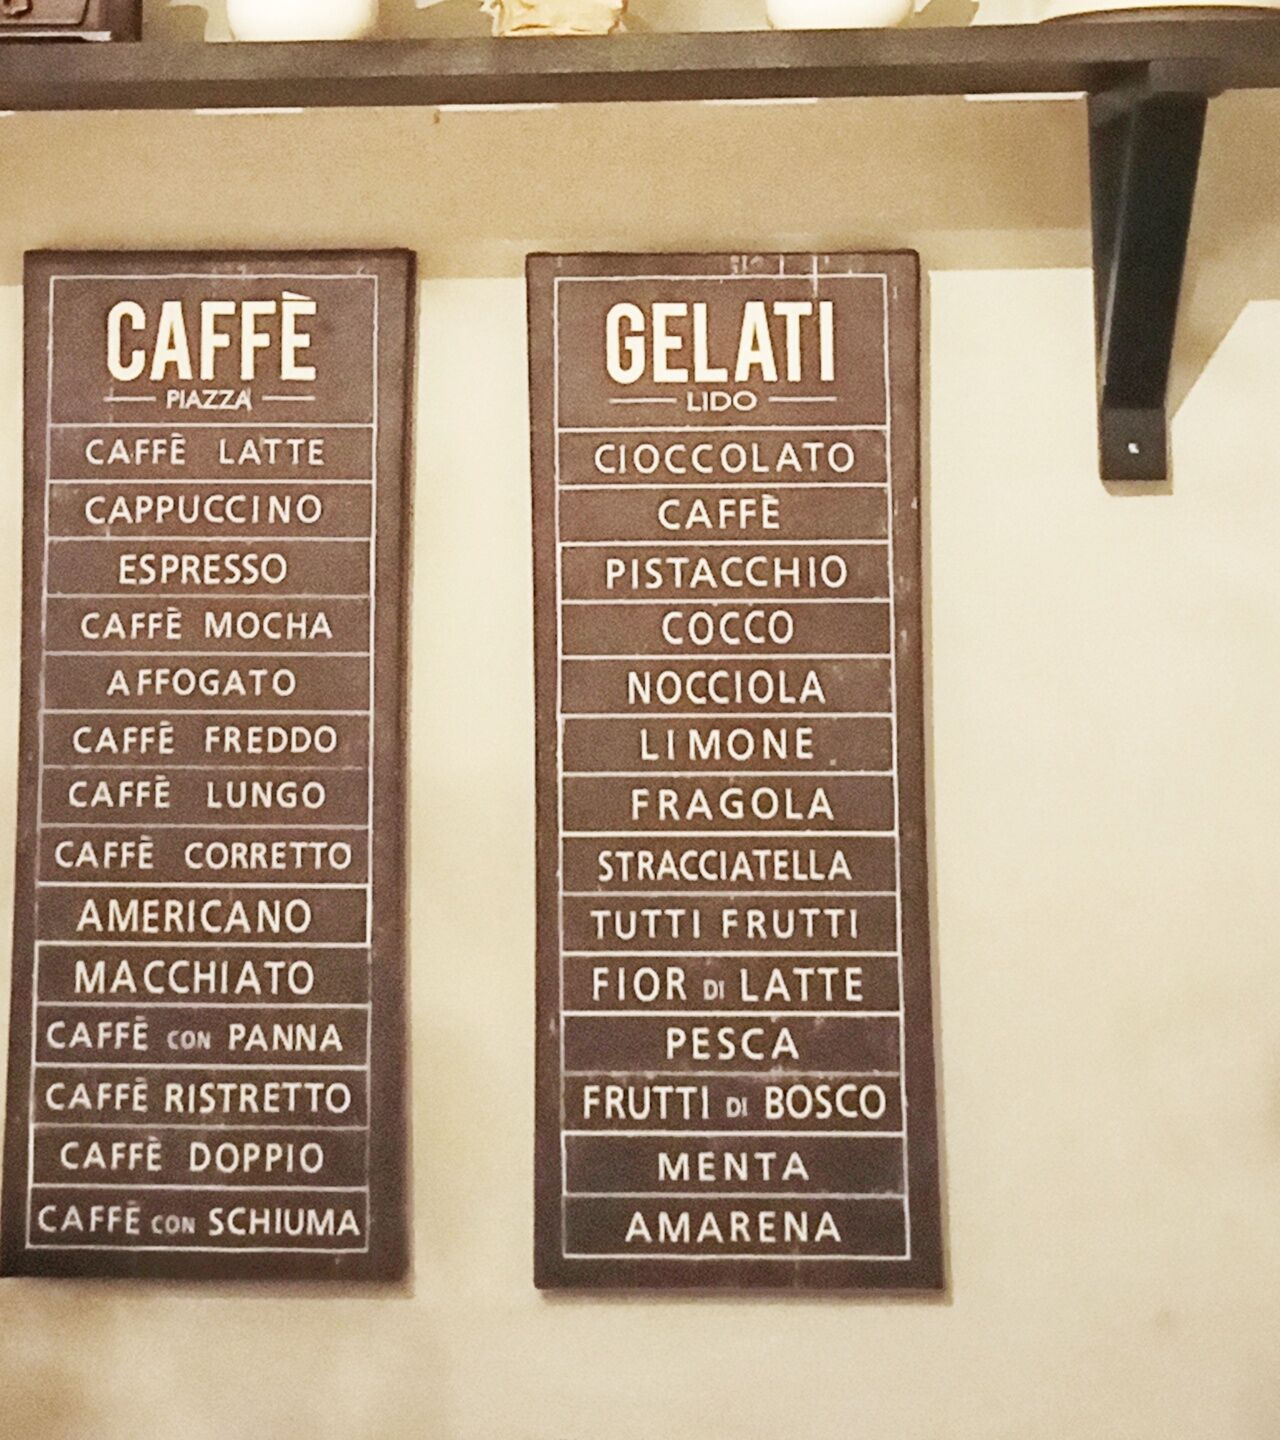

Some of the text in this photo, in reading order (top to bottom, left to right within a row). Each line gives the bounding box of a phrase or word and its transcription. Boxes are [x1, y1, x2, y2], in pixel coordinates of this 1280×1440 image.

[106, 290, 317, 382] CAFFÈ
[605, 300, 835, 385] GELATI
[166, 389, 253, 411] PIAZZA
[686, 390, 758, 413] LIDO
[84, 433, 325, 467] CAFFÈ LATTE
[594, 442, 855, 474] CIOCCOLATO
[83, 493, 324, 525] CAPPUCCINO
[658, 494, 781, 530] CAFFÈ
[118, 553, 289, 585] ESPRESSO
[606, 555, 848, 590] PISTACCHIO
[79, 607, 334, 640] CAFFÈ MOCHA
[662, 610, 795, 646] COCCO
[106, 668, 297, 697] AFFOGATO
[627, 669, 826, 705] NOCCIOLA
[72, 720, 338, 755] CAFFÈ FREDDO
[640, 727, 814, 761] LIMONE
[68, 774, 326, 809] CAFFÈ LUNGO
[631, 787, 834, 821] FRAGOLA
[54, 835, 353, 871] CAFFÈ CORRETTO
[597, 849, 852, 882] STRACCIATELLA
[76, 898, 313, 935] AMERICANO
[589, 908, 858, 940] TUTTI FRUTTI
[74, 960, 315, 995] MACCHIATO
[592, 967, 863, 1002] FIOR DI LATTE
[46, 1015, 344, 1053] CAFFÈ CON PANNA
[666, 1027, 800, 1060] PESCA
[46, 1077, 352, 1114] CAFFÈ RISTRETTO
[583, 1084, 887, 1120] FRUTTI DI BOSCO
[60, 1136, 324, 1174] CAFFÈ DOPPIO
[658, 1152, 810, 1182] MENTA
[37, 1201, 361, 1237] CAFFÈ CON SCHIUMA
[625, 1211, 842, 1244] AMARENA
